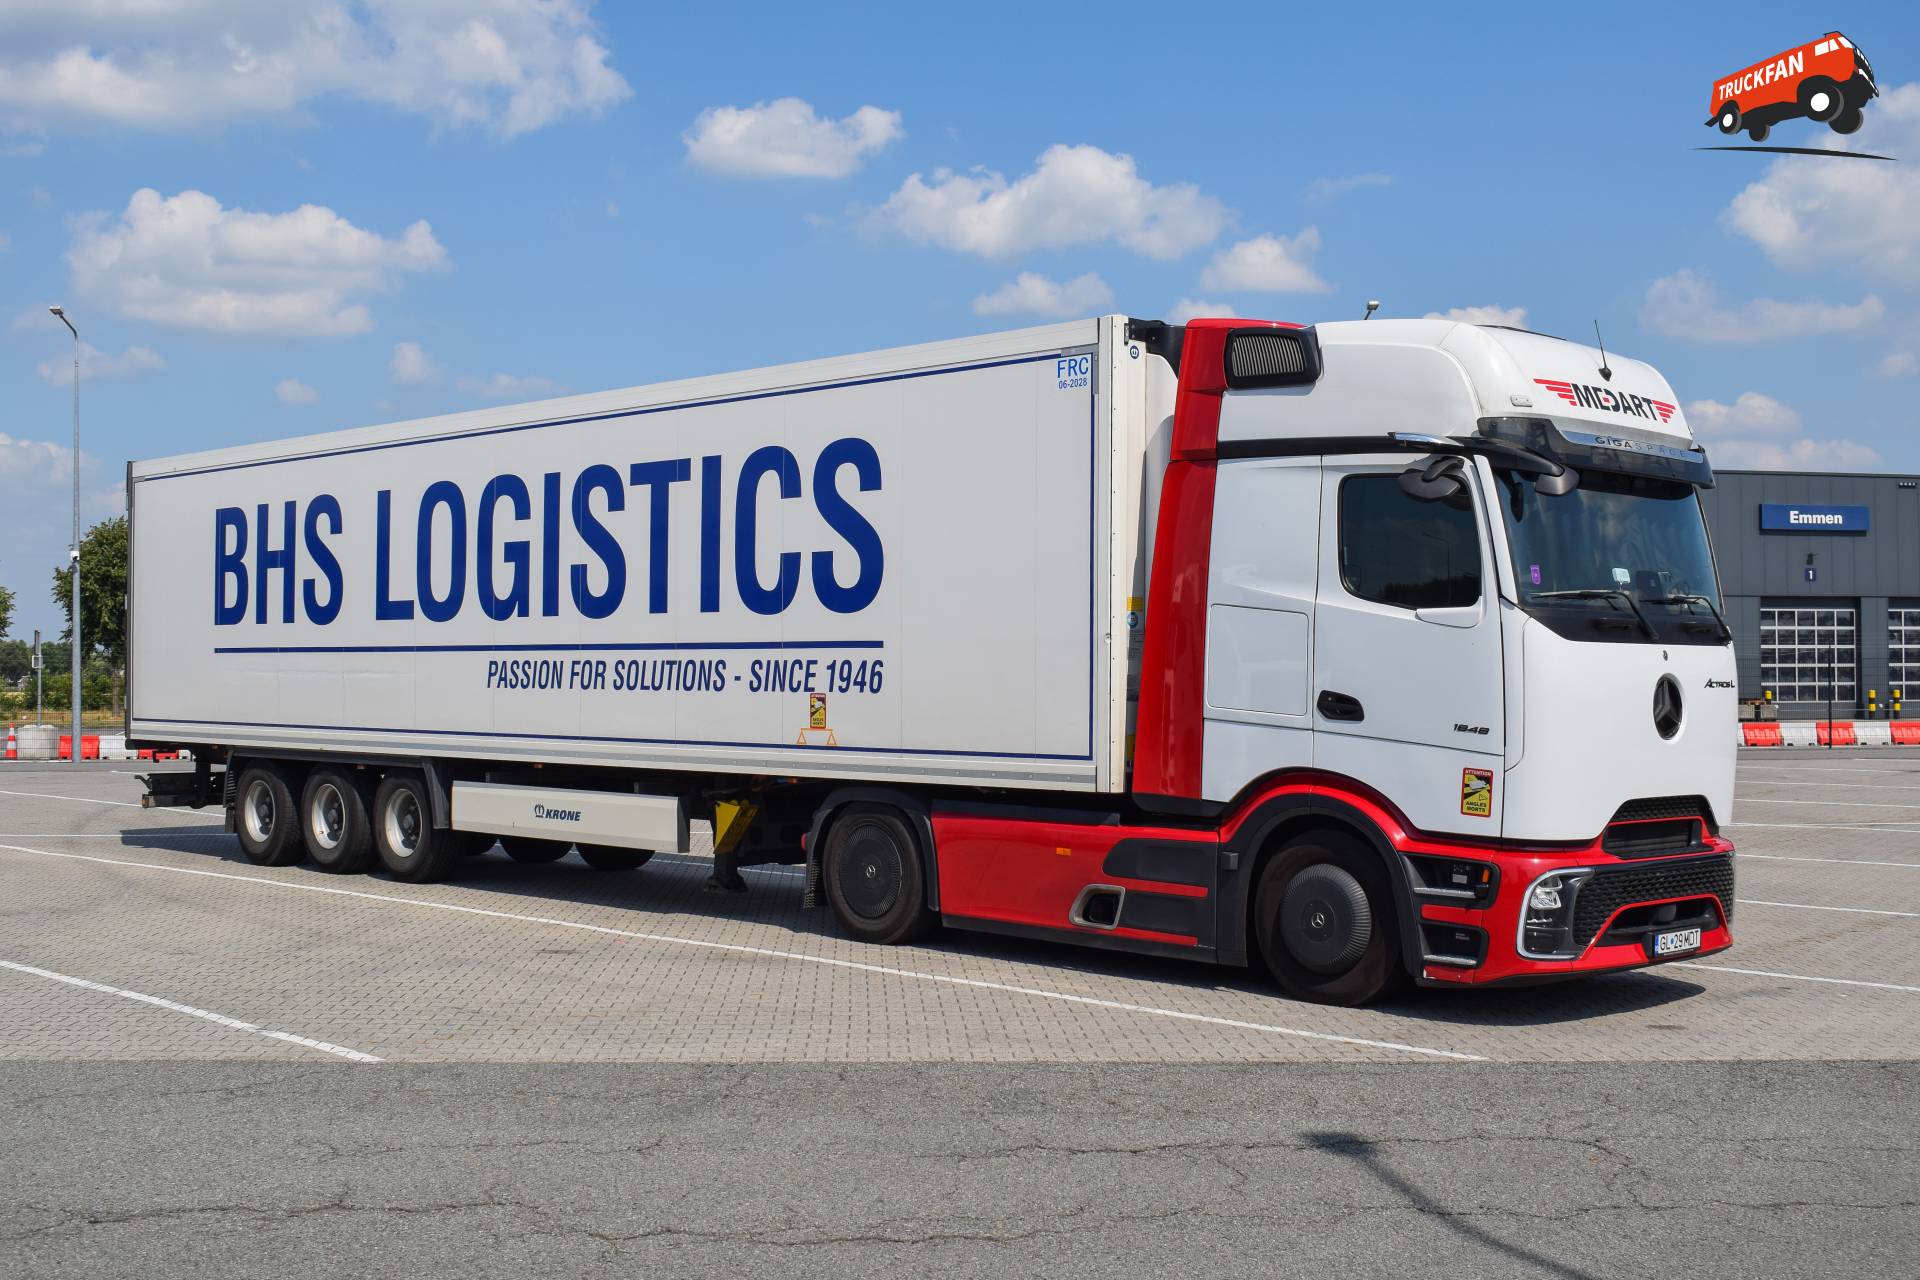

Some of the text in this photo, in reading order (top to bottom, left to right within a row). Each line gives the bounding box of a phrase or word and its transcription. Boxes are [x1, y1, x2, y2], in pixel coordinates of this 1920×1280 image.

[1057, 357, 1089, 378] FRC
[1058, 377, 1088, 389] 06-2028
[1571, 383, 1658, 421] MEDART
[1789, 511, 1843, 525] Emmen
[214, 437, 884, 625] BHS LOGISTICS
[487, 659, 564, 690] PASSION
[569, 659, 607, 690] FOR
[613, 659, 726, 692] SOLUTIONS
[749, 659, 818, 693] SINCE
[826, 659, 884, 694] 1946
[1453, 723, 1490, 735] 1848
[545, 809, 581, 821] KRONE
[1660, 936, 1670, 950] GL
